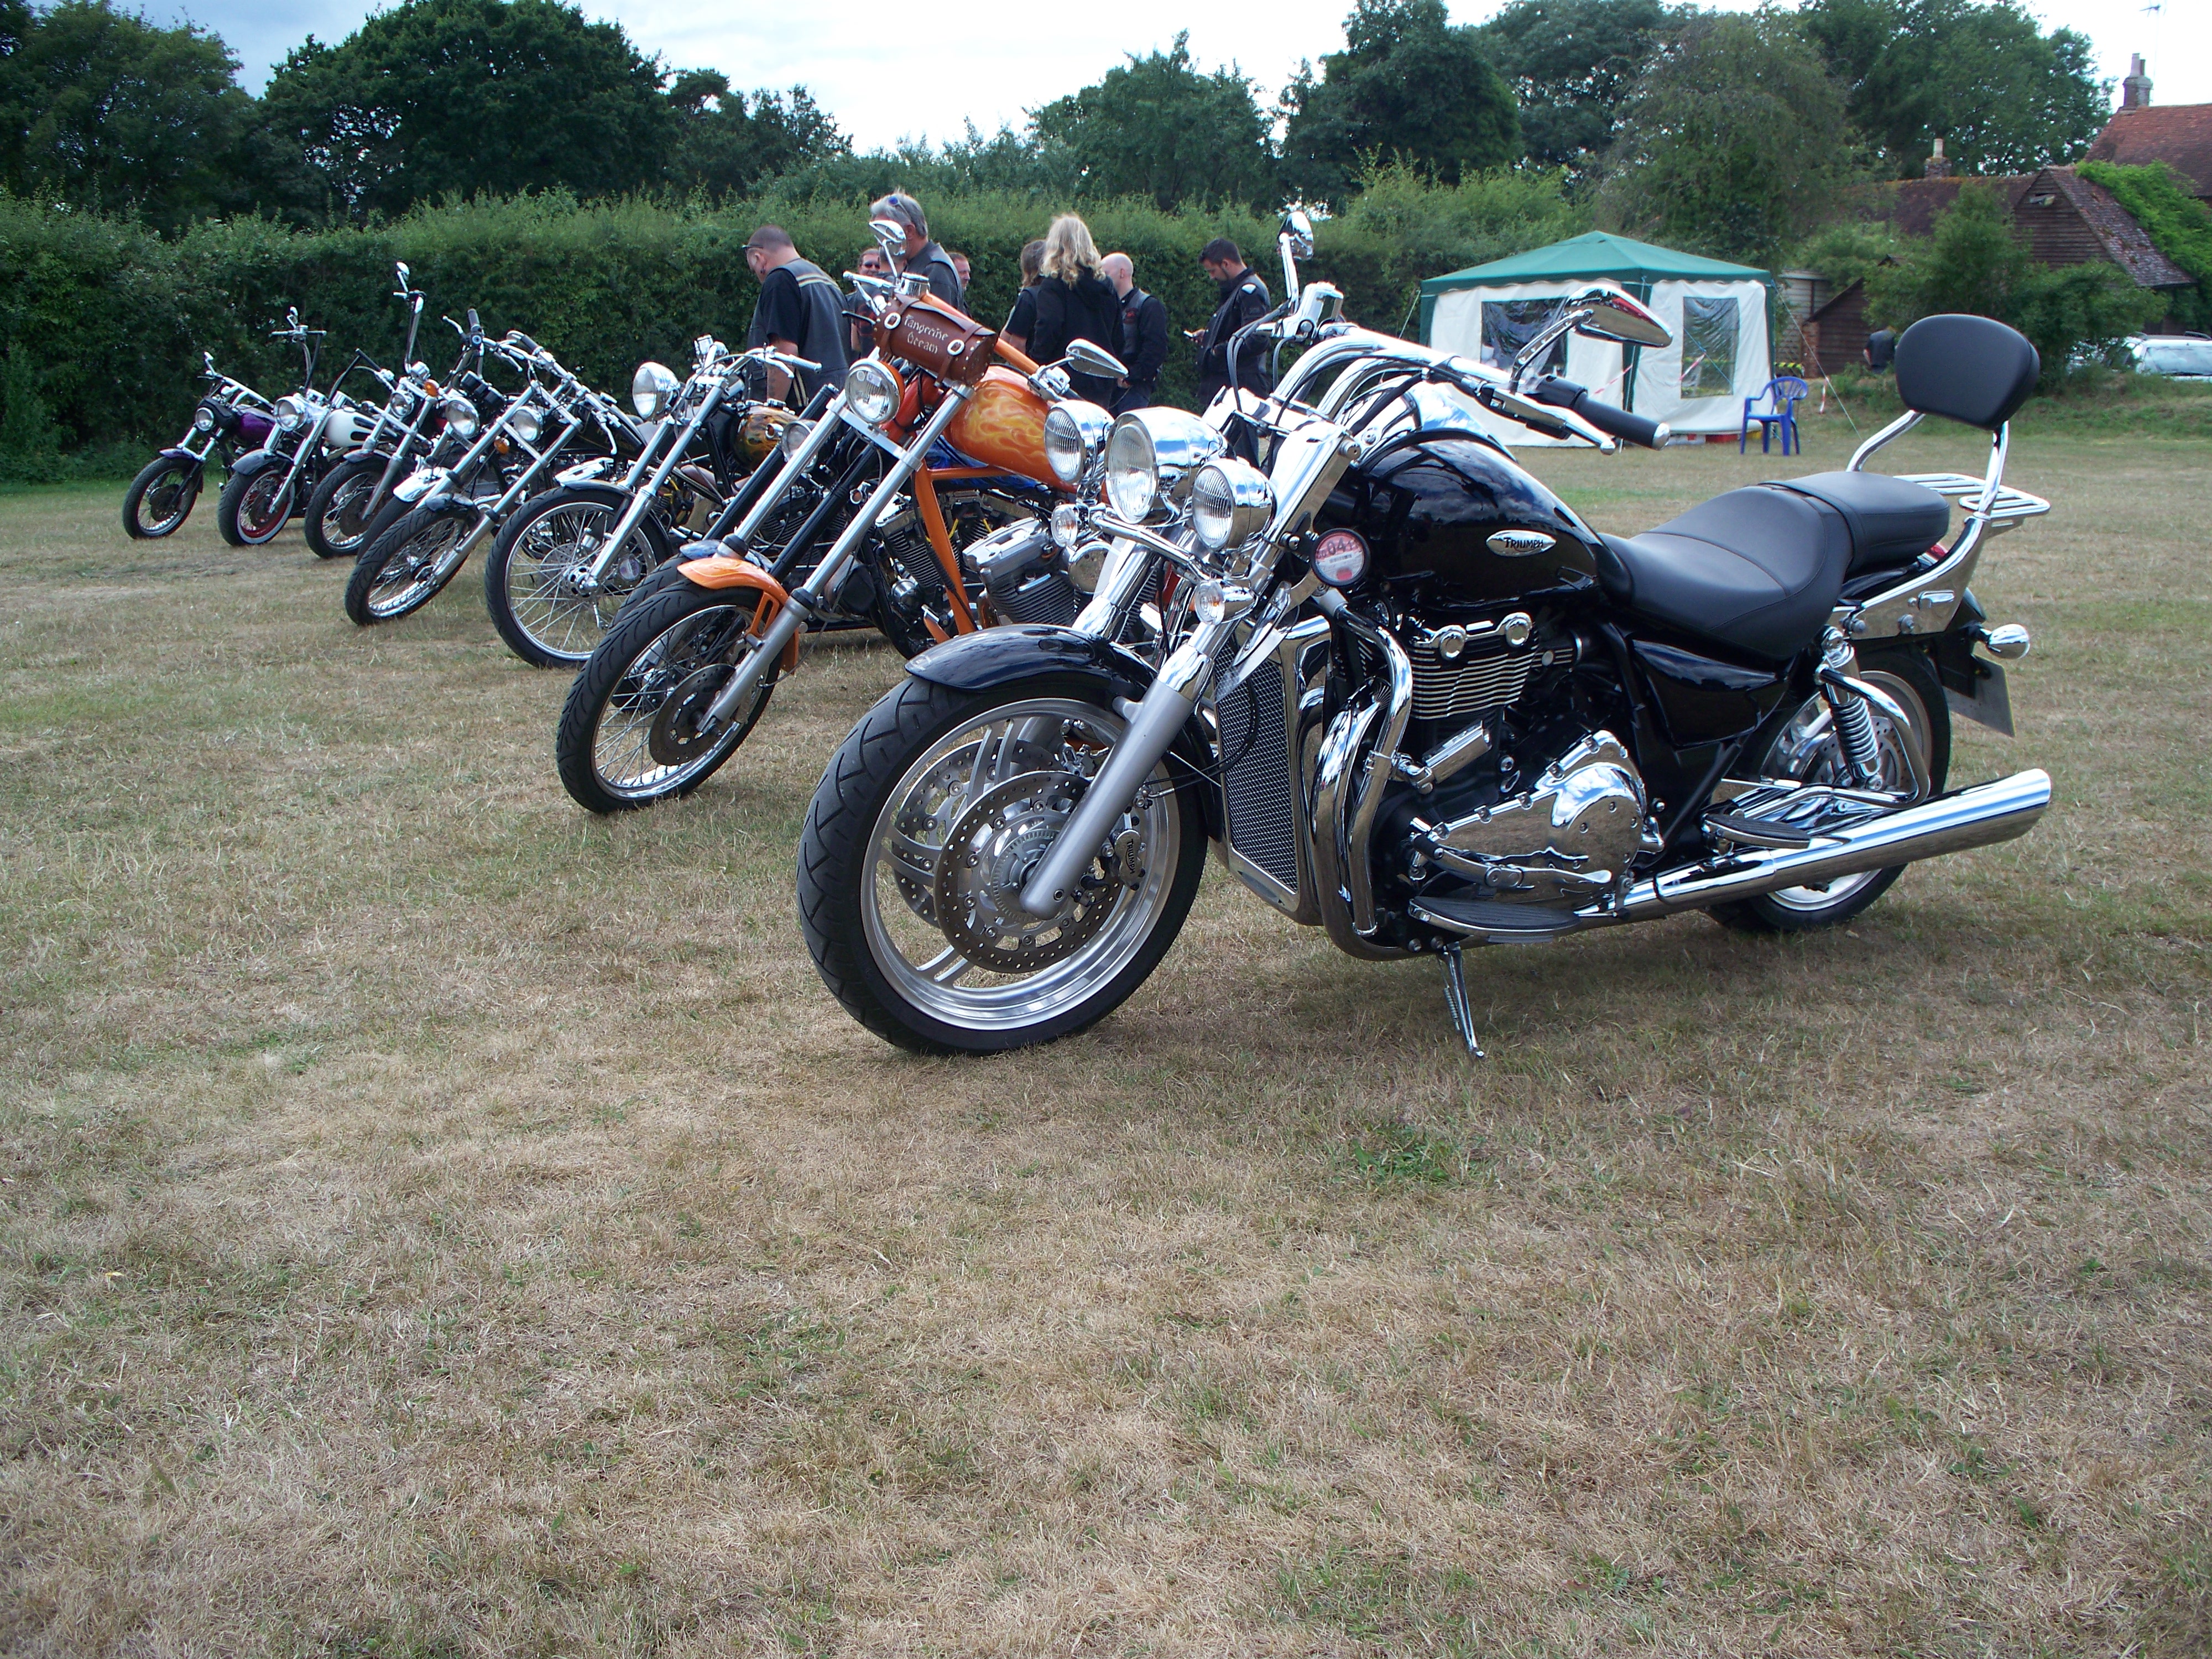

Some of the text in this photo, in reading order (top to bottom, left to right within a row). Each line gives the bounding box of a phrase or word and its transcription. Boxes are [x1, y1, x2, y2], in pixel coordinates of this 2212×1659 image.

[904, 314, 949, 341] Tangerine
[907, 332, 938, 354] Dream
[1503, 537, 1543, 549] TRIUMPH
[1126, 838, 1135, 874] TRIUMPH
